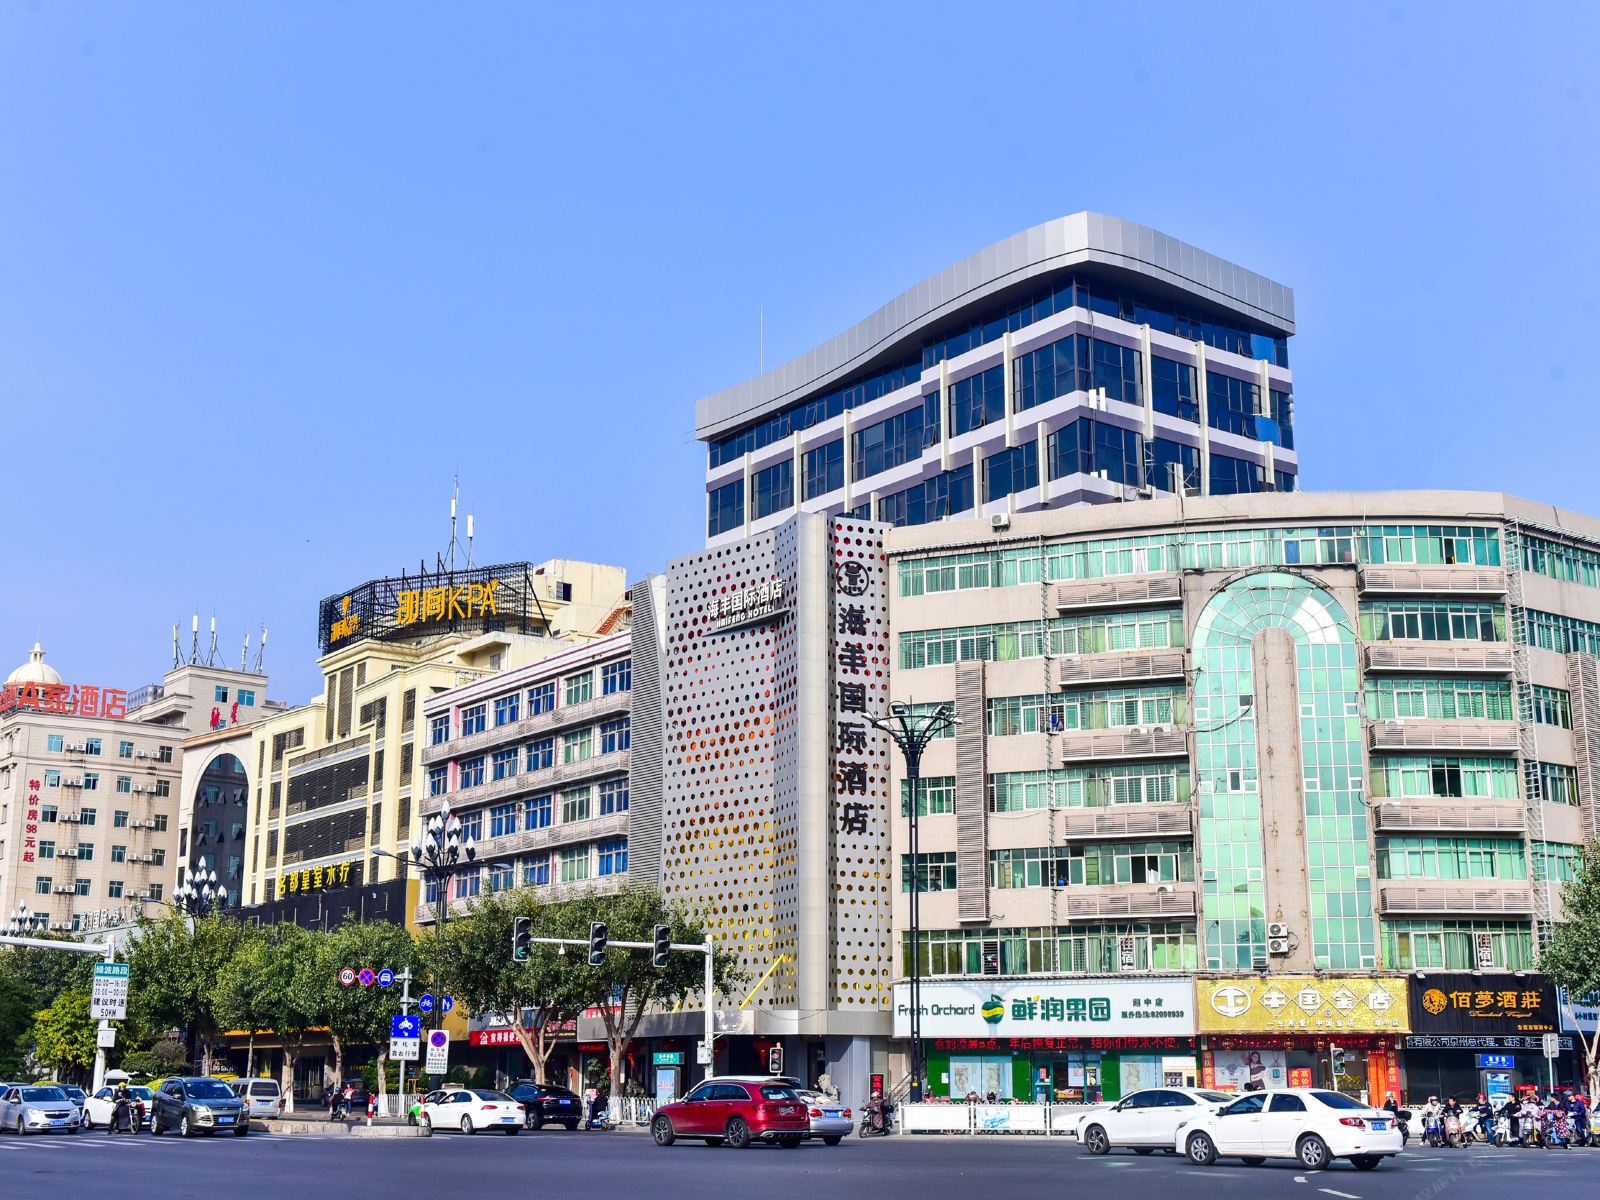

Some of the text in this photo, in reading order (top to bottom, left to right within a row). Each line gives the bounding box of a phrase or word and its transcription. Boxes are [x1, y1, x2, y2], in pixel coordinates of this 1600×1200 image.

[707, 578, 783, 619] 海丰国际酒店
[716, 604, 772, 629] HAIFENG HOTEL
[837, 605, 868, 835] 海丰国际酒店
[22, 779, 41, 863] 特价房98元起
[278, 860, 350, 895] 名都皇室水疗
[343, 971, 353, 980] 60
[93, 998, 125, 1007] 建议时速
[931, 1004, 975, 1016] Orchard
[1012, 995, 1111, 1021] 鲜润果园
[1449, 989, 1542, 1009] 佰夢酒莊
